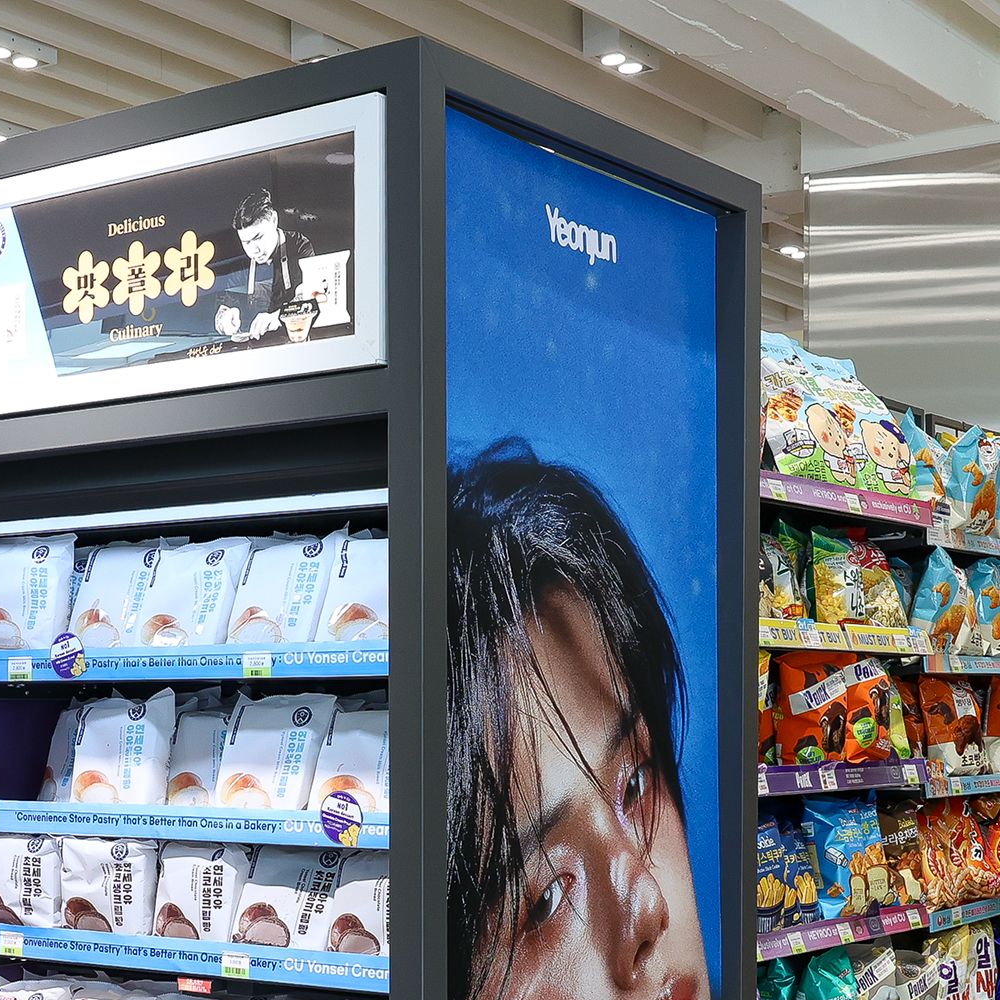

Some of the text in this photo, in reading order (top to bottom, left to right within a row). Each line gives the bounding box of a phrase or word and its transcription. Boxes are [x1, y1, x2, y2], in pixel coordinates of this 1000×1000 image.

[108, 214, 166, 237] Delicious
[545, 203, 617, 265] Yeonjun
[109, 323, 164, 342] Culinary
[783, 628, 796, 640] BUY
[826, 632, 841, 644] BUY
[857, 634, 889, 646] MUST BUY
[149, 658, 175, 667] Better
[178, 657, 197, 666] than
[200, 656, 223, 666] Ones
[225, 656, 233, 665] in
[284, 651, 304, 665] CU
[307, 651, 349, 665] Yonsei
[69, 814, 91, 823] Store
[123, 815, 147, 825] that's
[150, 816, 176, 826] Better
[178, 818, 198, 828] than
[200, 819, 224, 829] Ones
[225, 820, 234, 829] in
[244, 820, 277, 832] Bakery
[284, 820, 304, 832] CU
[361, 824, 389, 835] rea
[32, 857, 42, 897] 연세우유
[122, 863, 133, 905] 연세우유
[213, 865, 224, 910] 연세우유
[807, 929, 832, 941] HEYROO
[23, 938, 68, 949] onvenience
[70, 941, 92, 951] Store
[124, 946, 147, 956] that's
[150, 948, 177, 959] Better
[178, 952, 198, 961] than
[200, 953, 223, 964] Ones
[250, 958, 277, 971] akery
[284, 958, 304, 971] CU
[307, 961, 349, 976] Yonsei
